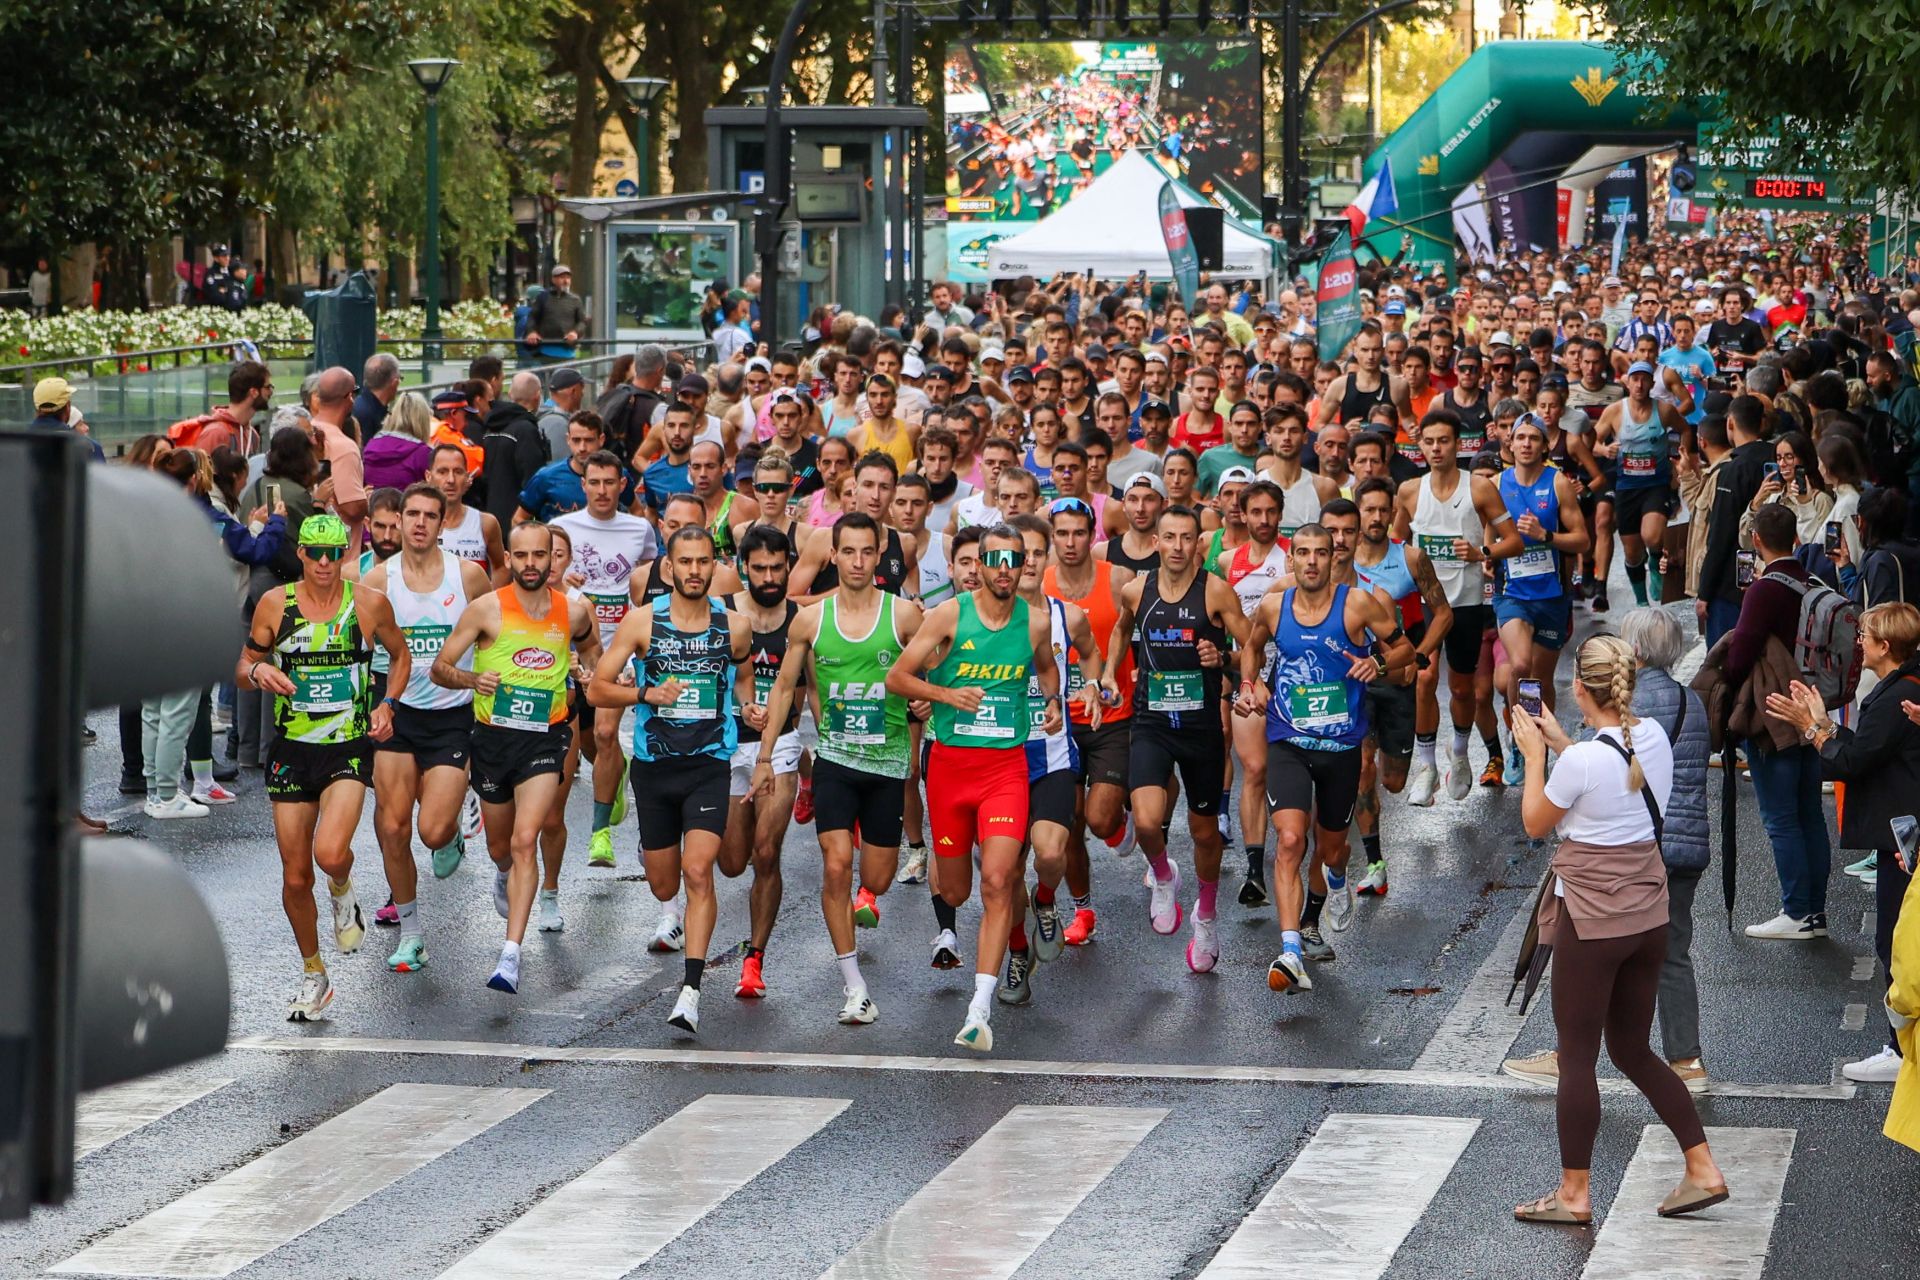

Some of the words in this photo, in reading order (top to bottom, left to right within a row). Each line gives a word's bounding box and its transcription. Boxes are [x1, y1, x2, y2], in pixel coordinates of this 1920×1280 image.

[1440, 128, 1472, 158] RURAL
[1467, 98, 1502, 130] KUTXA
[1755, 181, 1826, 198] 0:00:14
[1626, 459, 1651, 467] 2633
[463, 550, 481, 558] 8:30
[1424, 545, 1457, 556] 1341
[1513, 551, 1548, 565] 3583
[596, 605, 624, 617] 622
[405, 637, 445, 653] 2001
[291, 657, 305, 665] RUN
[308, 655, 329, 665] WITH
[331, 653, 354, 664] LEIVA
[517, 653, 553, 664] Serrano
[309, 683, 333, 698] 22
[677, 688, 700, 703] 23
[829, 682, 886, 700] LEA
[1164, 683, 1185, 697] 15
[510, 698, 535, 715] 20
[1308, 696, 1329, 712] 27
[976, 705, 997, 721] 21
[845, 714, 868, 730] 24
